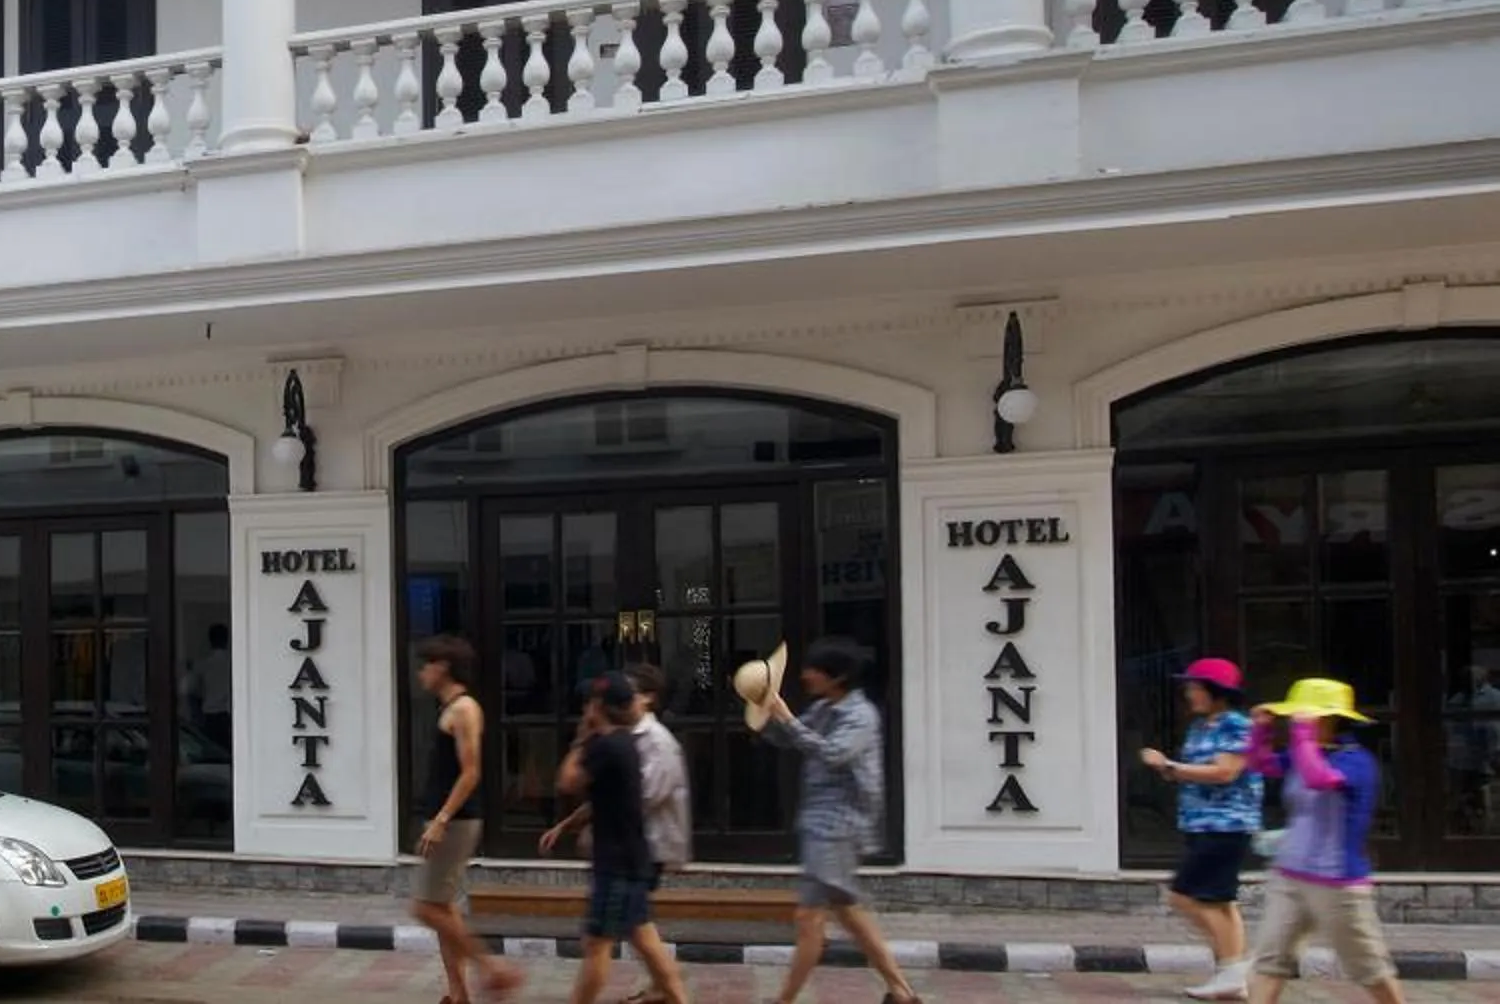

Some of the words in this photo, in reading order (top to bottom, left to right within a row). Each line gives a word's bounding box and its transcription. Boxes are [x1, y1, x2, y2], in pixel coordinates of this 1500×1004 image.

[261, 548, 355, 573] HOTEL
[947, 517, 1069, 546] HOTEL
[287, 580, 332, 806] AJANTA
[982, 553, 1038, 812] AJANTA
